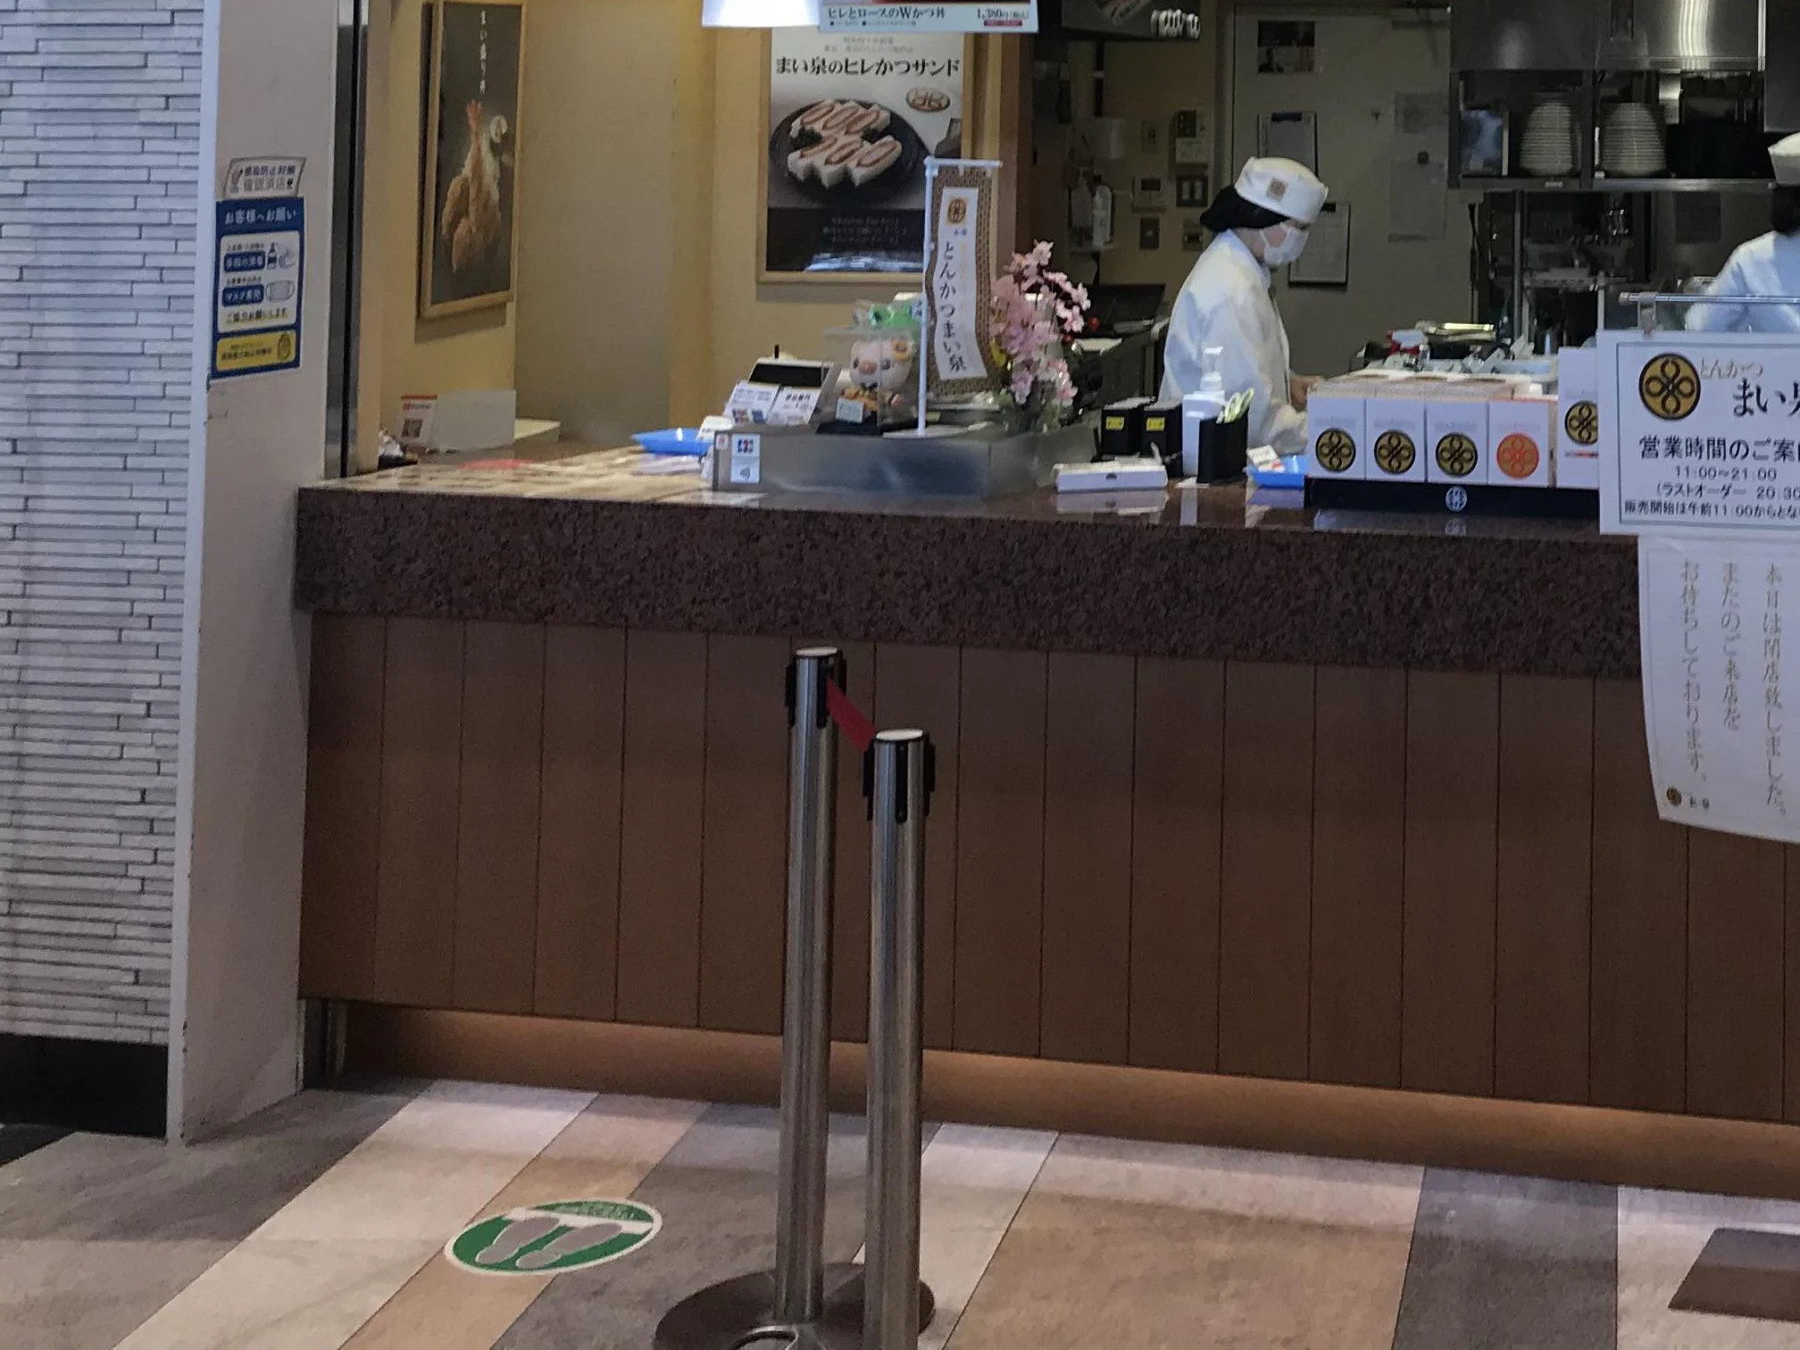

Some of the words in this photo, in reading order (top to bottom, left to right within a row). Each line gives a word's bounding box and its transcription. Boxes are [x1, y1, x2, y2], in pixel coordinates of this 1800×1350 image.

[776, 56, 960, 77] まい泉のヒレかつサンド
[1701, 358, 1764, 380] とんかつ
[1680, 559, 1708, 782] お待ちしております。
[1721, 559, 1741, 731] またのご来店を
